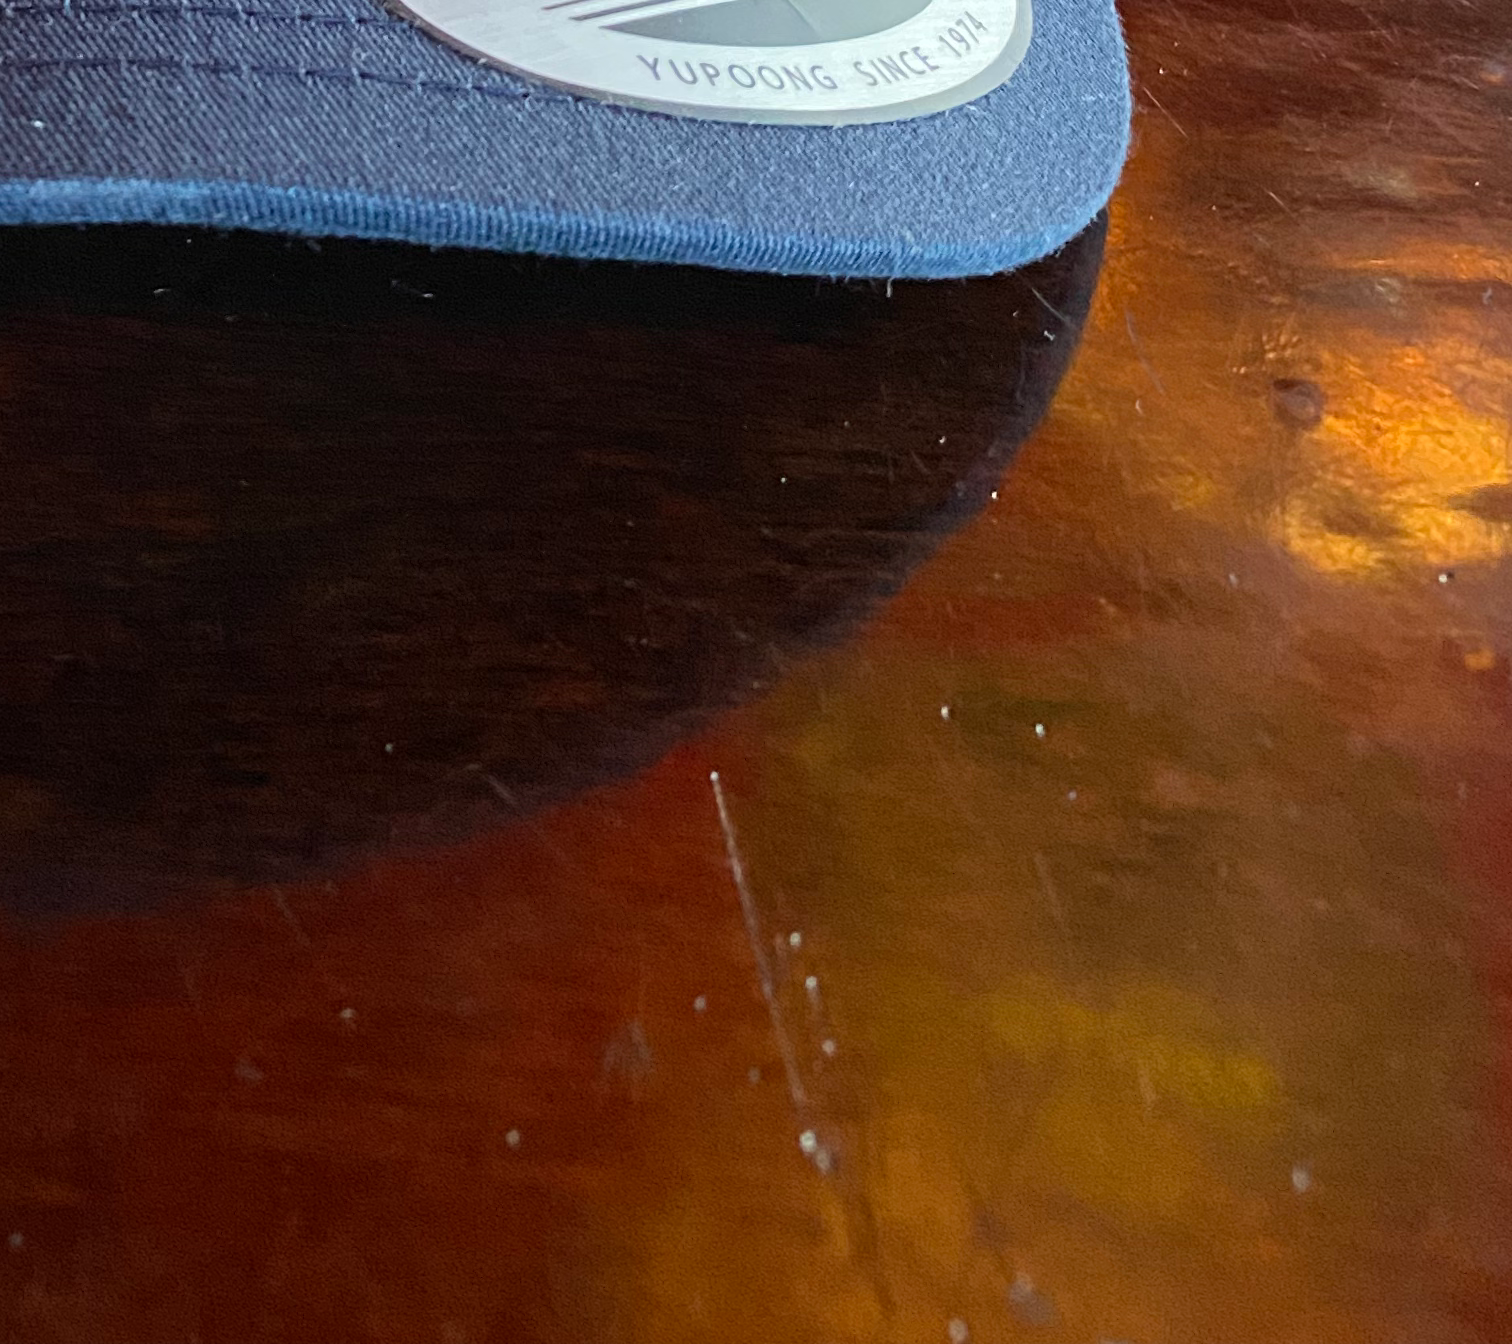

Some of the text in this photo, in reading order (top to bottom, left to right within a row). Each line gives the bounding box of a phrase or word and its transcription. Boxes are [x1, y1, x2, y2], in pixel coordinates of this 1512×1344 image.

[636, 10, 989, 91] YUPOONG SINCE 1974
